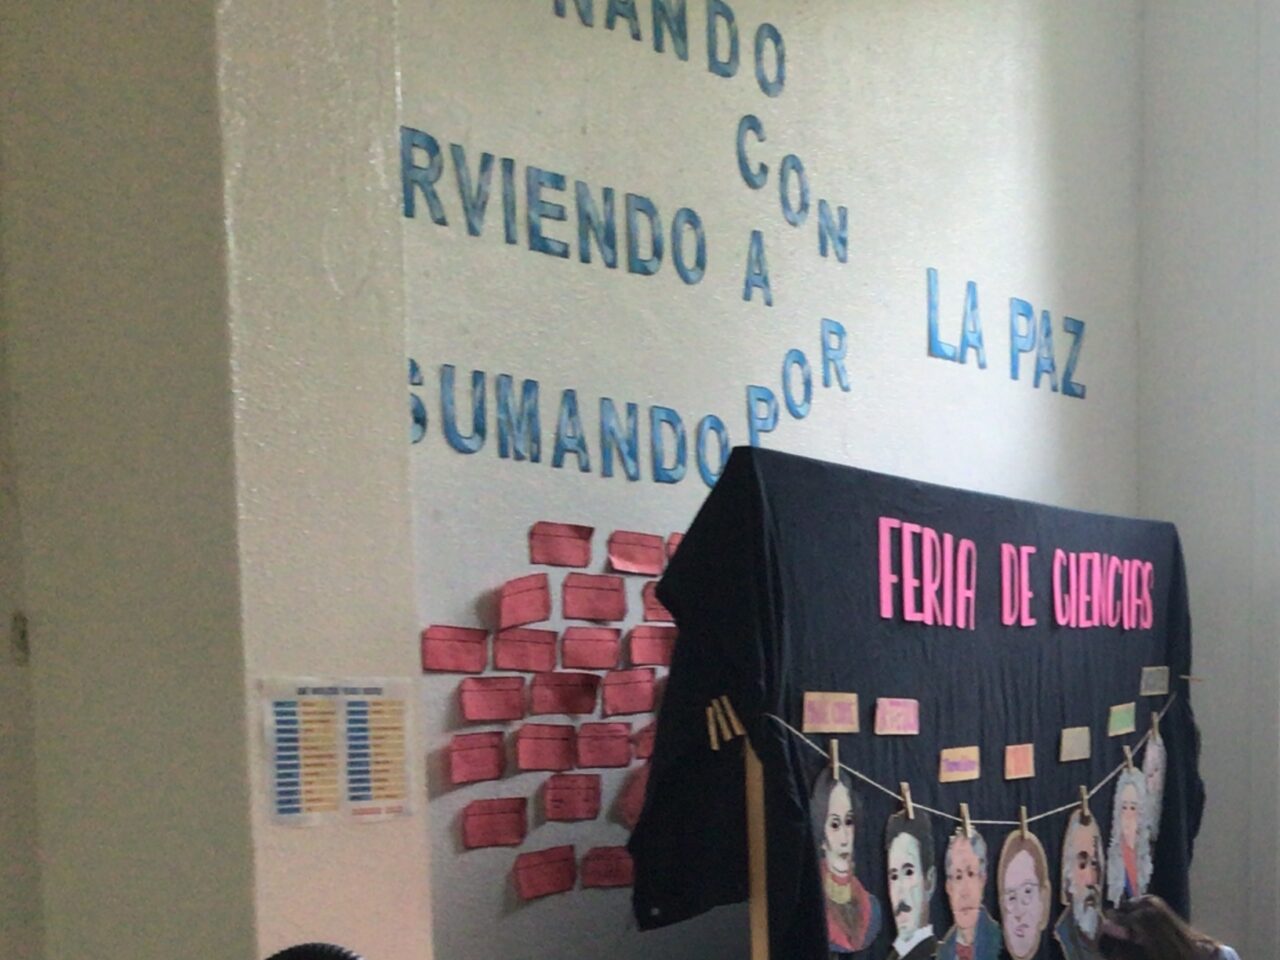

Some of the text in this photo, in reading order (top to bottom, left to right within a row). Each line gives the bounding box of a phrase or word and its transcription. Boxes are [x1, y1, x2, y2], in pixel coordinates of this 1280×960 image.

[400, 126, 773, 306] RVIENDO A
[736, 114, 848, 263] CON
[746, 317, 851, 448] POR
[926, 268, 1087, 399] LA PAZ
[878, 516, 1155, 631] FERIA DE CIENCIAS
